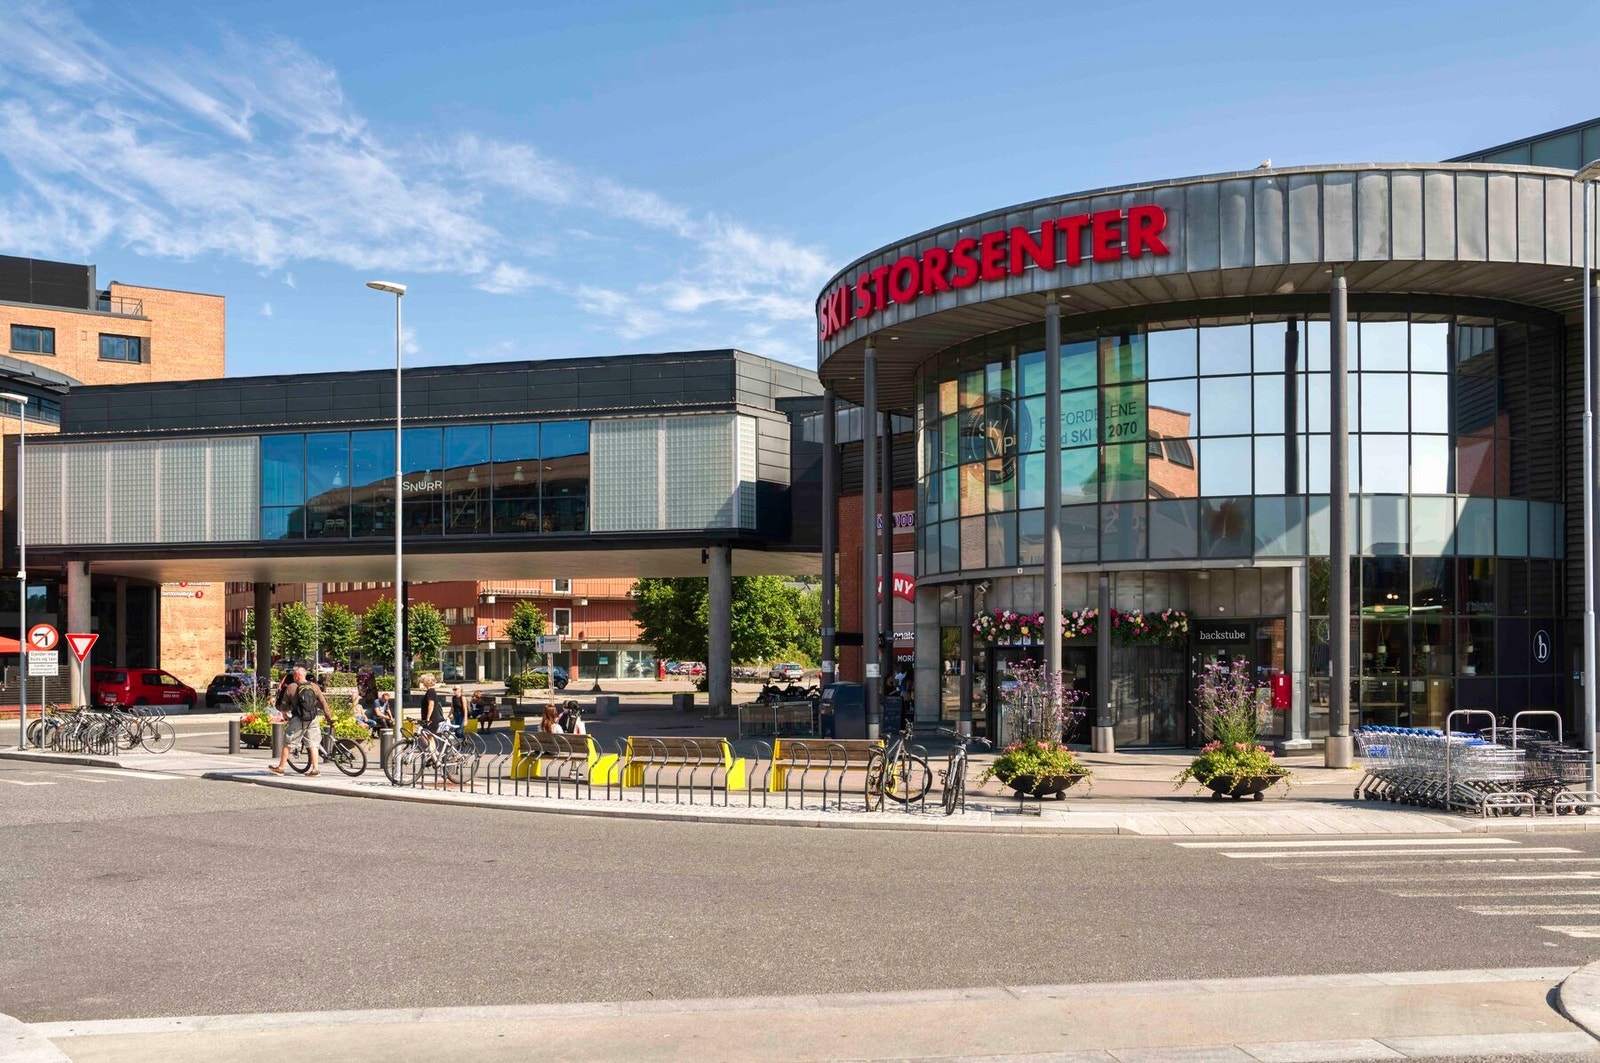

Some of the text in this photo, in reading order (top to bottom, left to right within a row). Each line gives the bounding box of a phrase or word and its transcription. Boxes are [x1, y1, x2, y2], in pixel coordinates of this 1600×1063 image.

[819, 204, 1171, 341] SKI STORSENTER
[1071, 427, 1092, 443] SKI
[1108, 421, 1138, 438] 2070
[402, 480, 443, 493] SNURR
[1199, 630, 1246, 640] backstube
